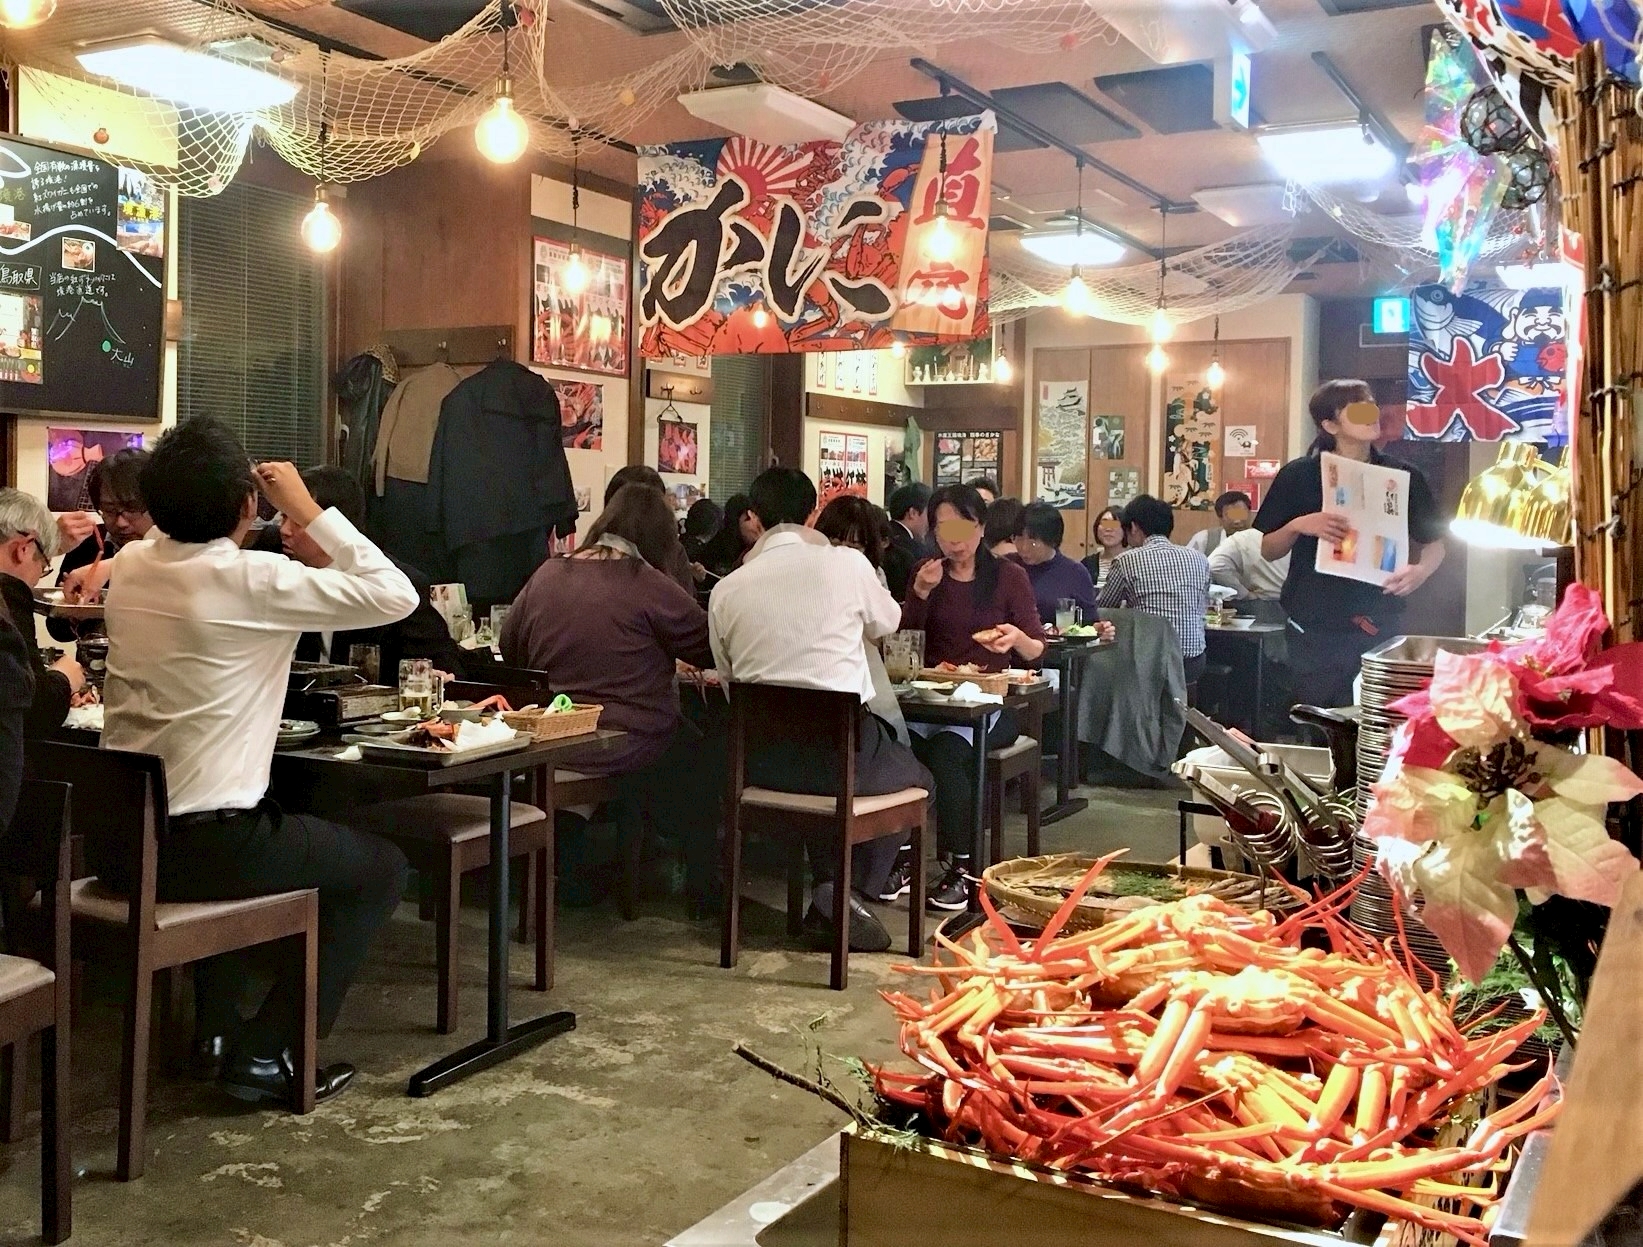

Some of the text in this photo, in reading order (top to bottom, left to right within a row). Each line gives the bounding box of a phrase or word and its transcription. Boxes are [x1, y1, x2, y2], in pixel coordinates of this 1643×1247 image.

[641, 178, 892, 324] かに
[0, 263, 38, 285] 鳥取県
[110, 347, 135, 366] 大山
